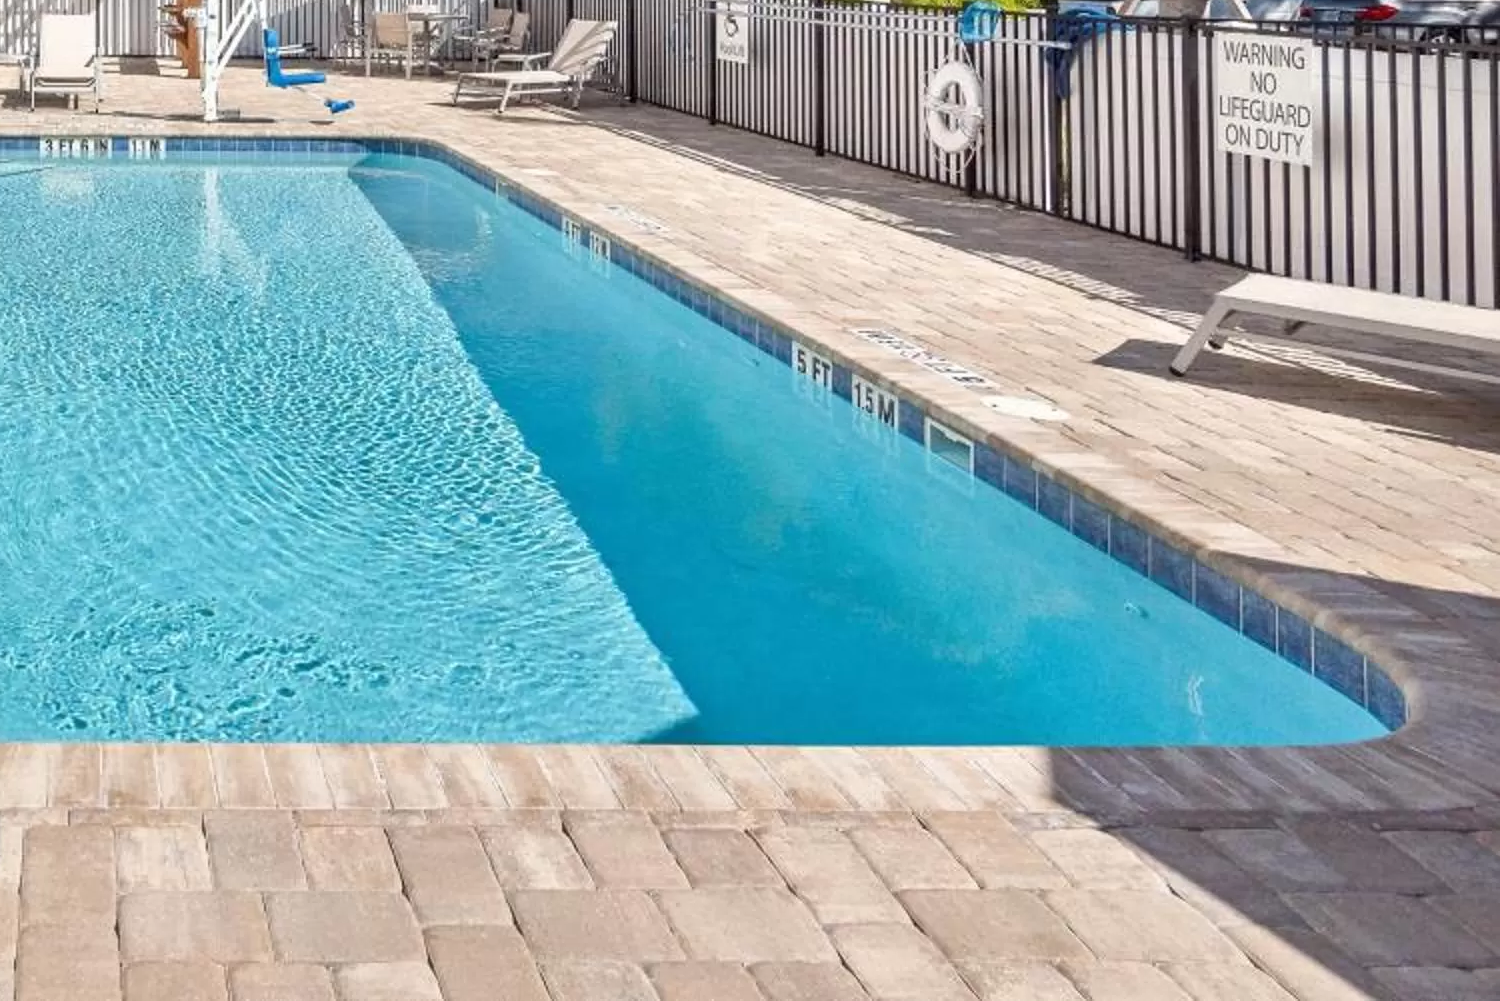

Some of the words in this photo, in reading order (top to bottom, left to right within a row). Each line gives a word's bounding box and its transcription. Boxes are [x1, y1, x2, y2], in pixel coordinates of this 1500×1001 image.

[1223, 40, 1305, 70] WARNING
[1251, 71, 1277, 95] NO
[1219, 95, 1311, 128] LIFEGUARD
[60, 138, 73, 151] FT
[1225, 123, 1251, 147] ON
[1255, 128, 1304, 155] DUTY
[797, 349, 807, 375] 5
[812, 356, 831, 388] FT
[855, 381, 874, 414] 1.5
[878, 395, 896, 428] M
